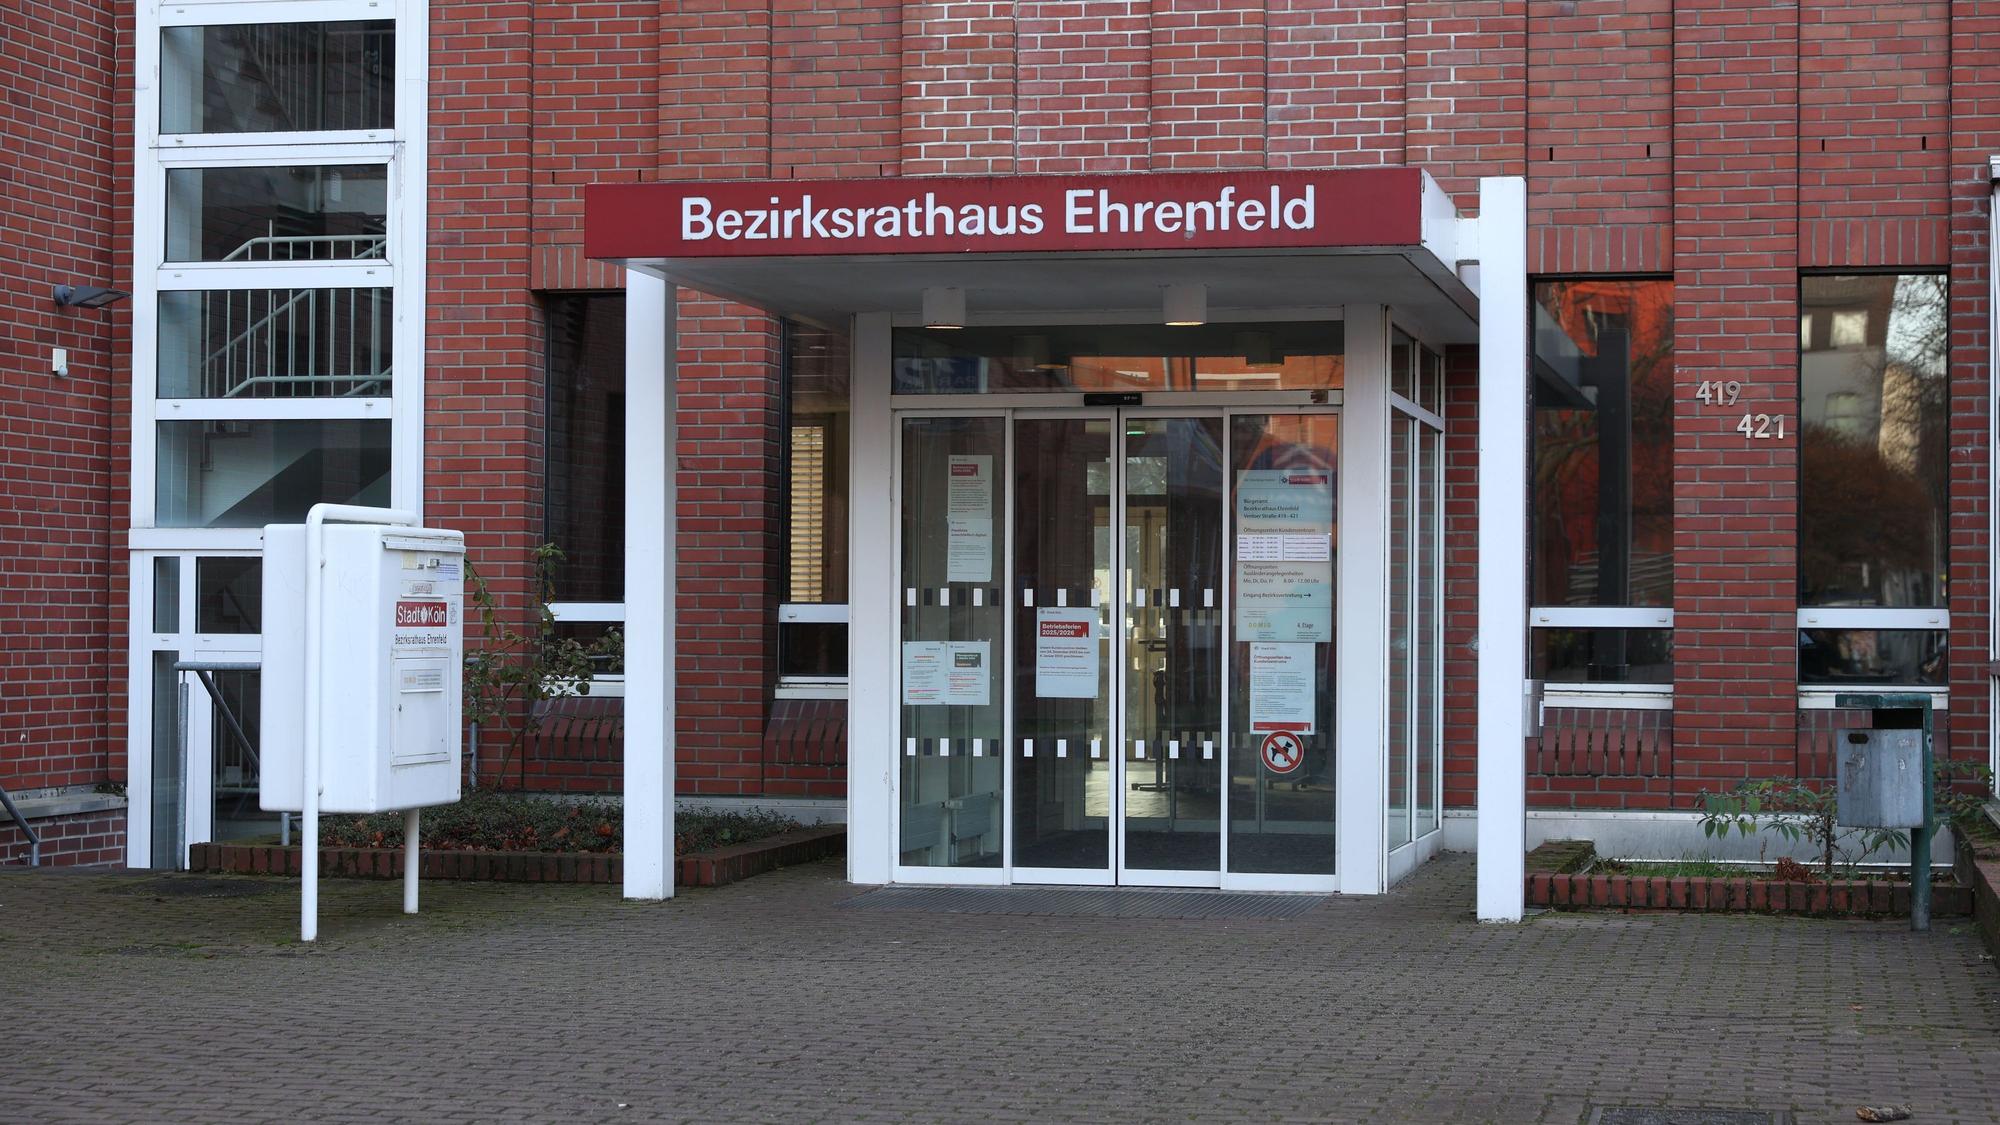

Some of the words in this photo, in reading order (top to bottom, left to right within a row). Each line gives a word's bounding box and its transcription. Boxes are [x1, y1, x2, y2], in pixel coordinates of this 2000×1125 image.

[681, 193, 1044, 240] Bezirksrathaus
[1065, 184, 1315, 233] Ehrenfeld
[1695, 380, 1741, 406] 419
[1736, 413, 1785, 439] 421
[397, 605, 421, 624] Stadt
[427, 605, 446, 623] Köln
[395, 633, 426, 645] Bezirksrathaus
[427, 633, 447, 645] Ehrenfeld
